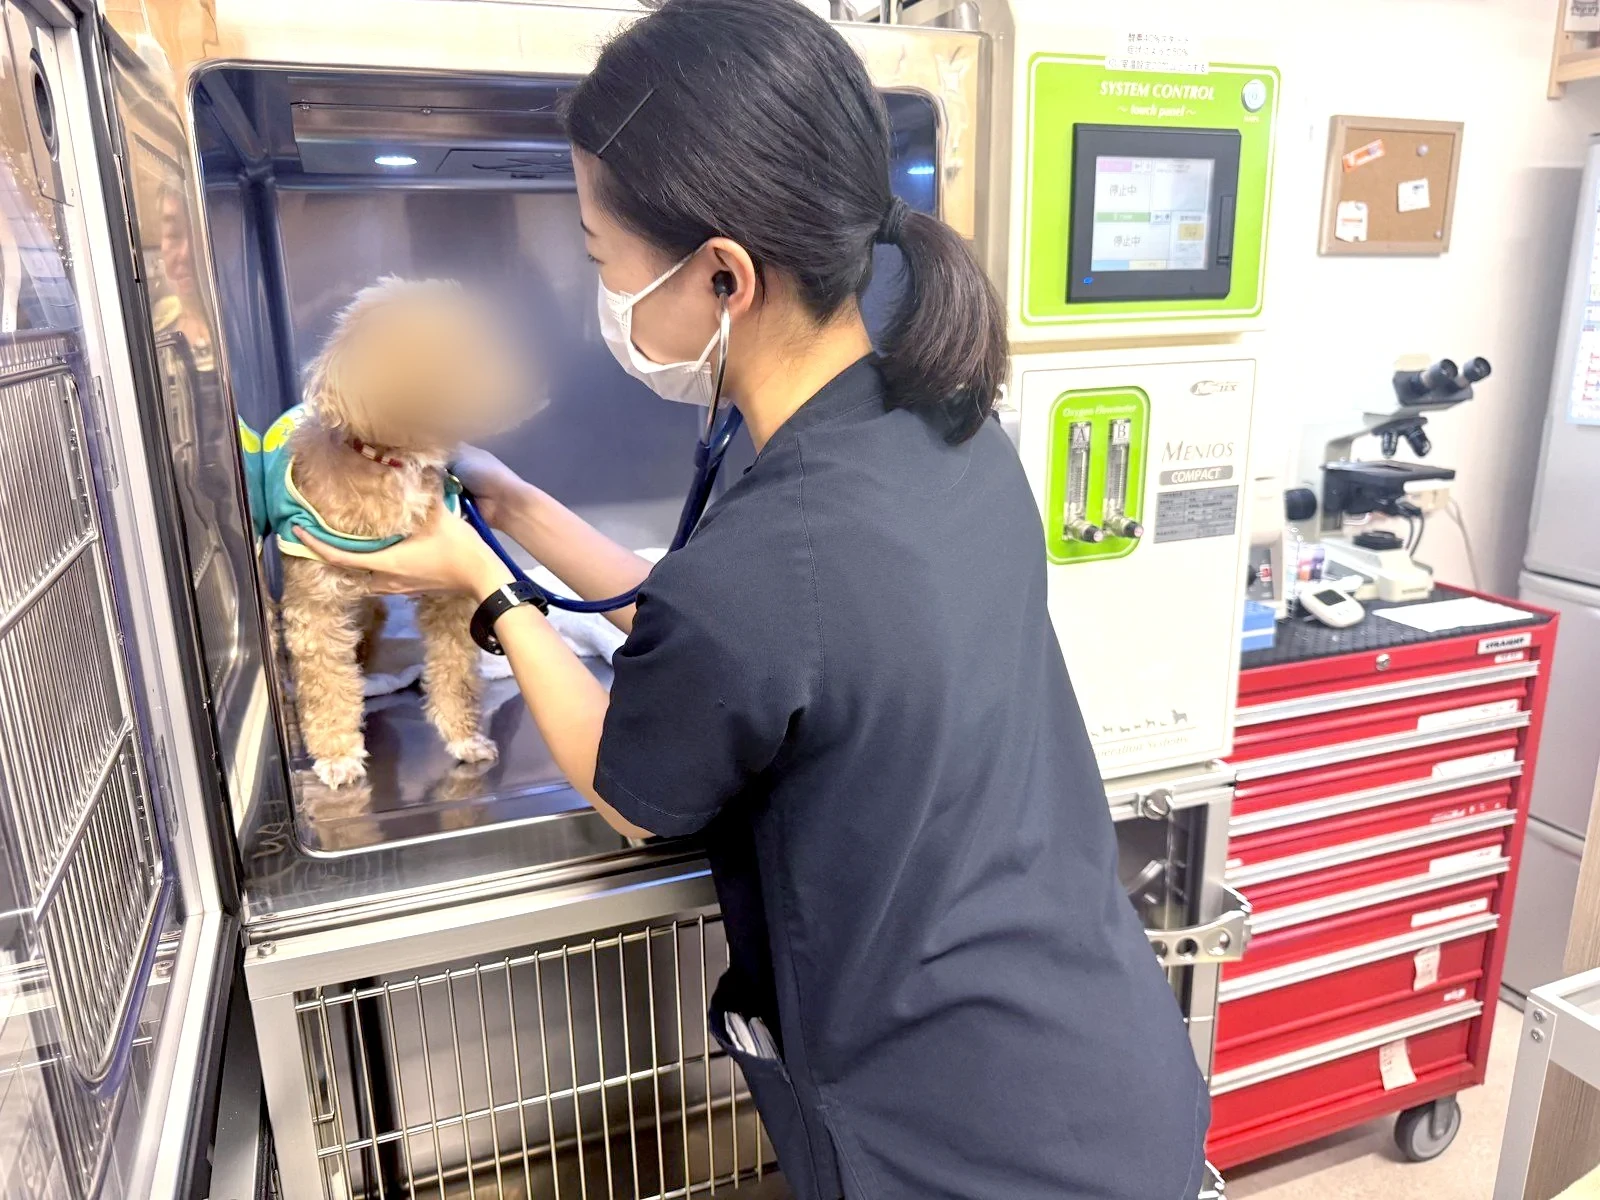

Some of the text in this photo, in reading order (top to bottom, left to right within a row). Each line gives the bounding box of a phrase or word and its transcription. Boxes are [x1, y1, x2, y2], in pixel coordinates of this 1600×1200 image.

[1100, 80, 1215, 101] SYSTEM CONTROL
[1130, 104, 1186, 119] touch panel
[1109, 184, 1137, 197] 停止中
[1113, 235, 1141, 247] 停止中
[1076, 428, 1087, 442] A
[1117, 424, 1127, 438] B
[1162, 441, 1234, 462] MENIOS
[1171, 467, 1222, 484] COMPACT
